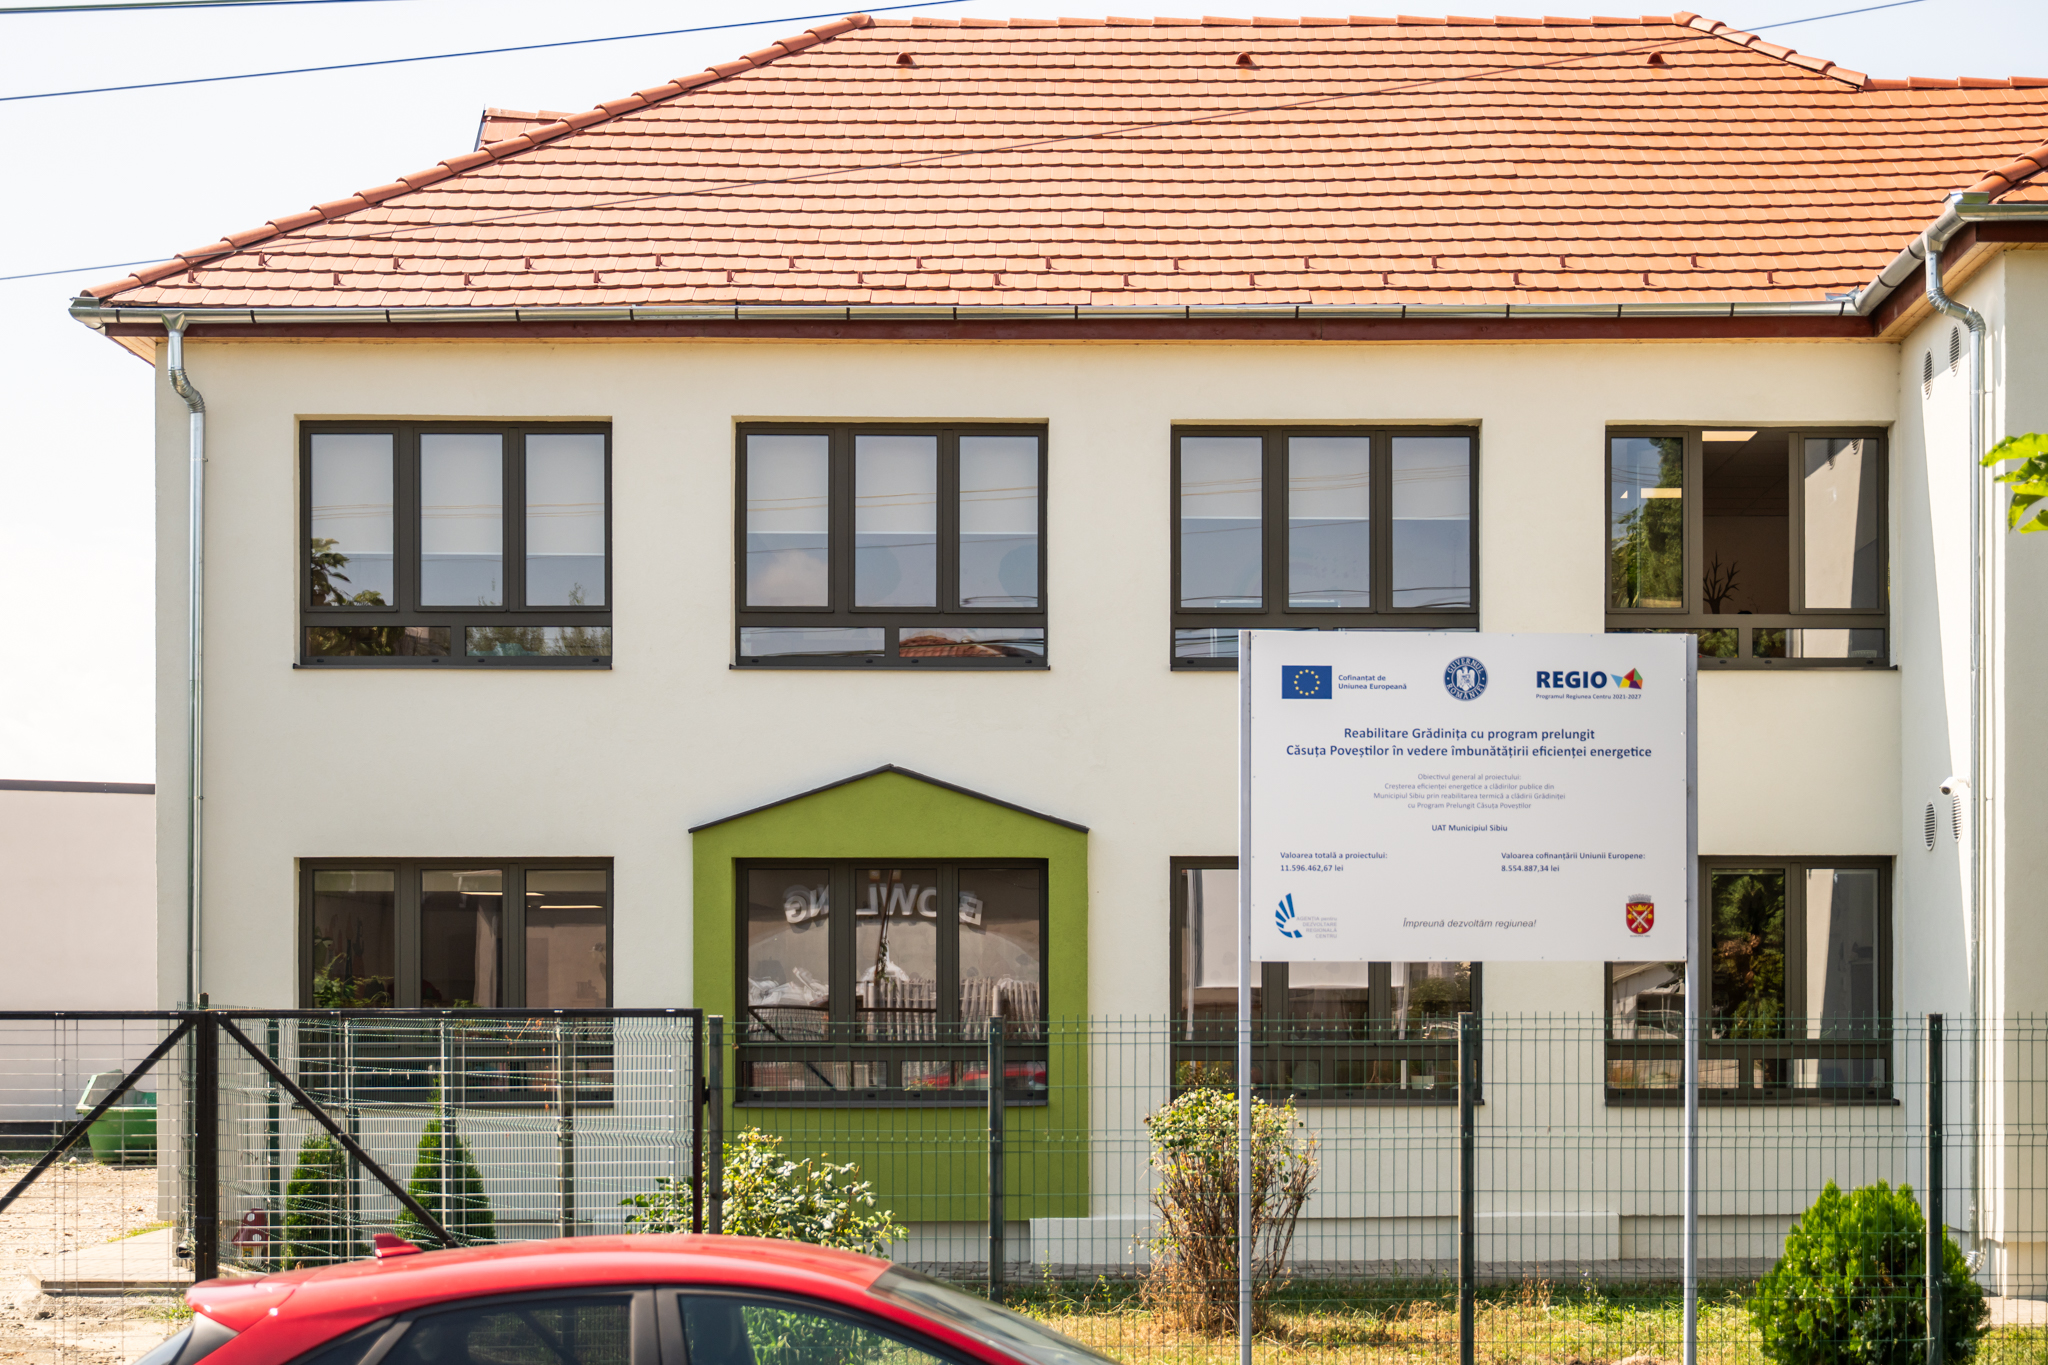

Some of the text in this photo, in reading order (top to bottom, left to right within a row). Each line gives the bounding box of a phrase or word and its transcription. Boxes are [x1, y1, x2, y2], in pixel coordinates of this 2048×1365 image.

[1447, 657, 1484, 674] GUVERNUL
[1338, 674, 1375, 683] Cofinanțat
[1536, 671, 1608, 689] REGIO
[1344, 728, 1595, 742] Reabilitare Grădinița cu program prelungit
[1286, 745, 1652, 760] Căsuța Poveștilor în vedere îmbunătățirii eficienței energetice
[1533, 792, 1566, 800] Grădiniței
[1448, 824, 1488, 832] Municipiul
[1345, 852, 1387, 860] proiectului:
[1535, 852, 1578, 860] cofinanțării
[1608, 852, 1645, 861] Europene:
[1280, 864, 1333, 873] 11.596.462,67
[1403, 917, 1537, 930] Împreună dezvoltăm regiunea!
